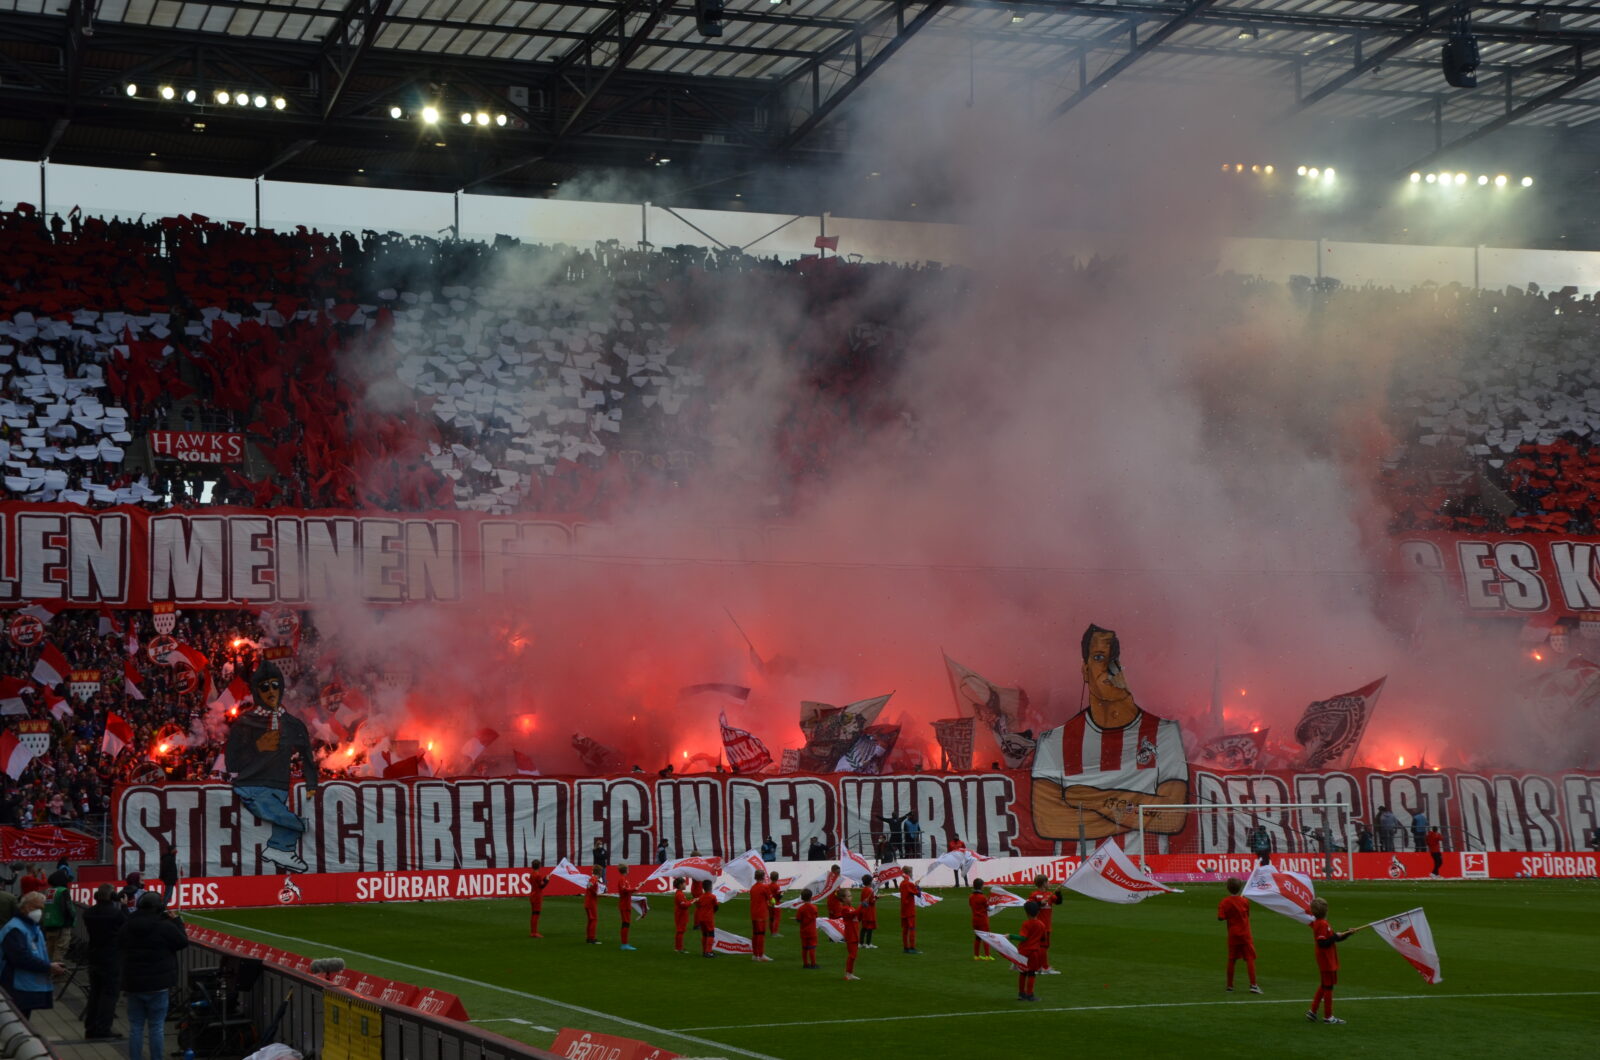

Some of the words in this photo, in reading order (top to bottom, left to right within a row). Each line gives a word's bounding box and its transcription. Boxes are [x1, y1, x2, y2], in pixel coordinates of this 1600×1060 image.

[152, 432, 241, 456] HAWKS
[178, 448, 221, 462] KÖLN
[148, 514, 461, 605] MEINEN
[1456, 541, 1550, 612] ES
[1550, 541, 1600, 612] K
[293, 781, 415, 874] ICH
[413, 779, 571, 872] BEIM
[655, 777, 723, 862] IN
[724, 777, 838, 862] DER
[840, 774, 1021, 860] KURVE
[1196, 771, 1293, 854] DER
[1367, 773, 1454, 853] IST
[1456, 774, 1563, 853] DAS
[1563, 774, 1600, 853] E
[355, 872, 449, 899] SPÜRBAR
[1522, 853, 1597, 876] SPÜRBAR
